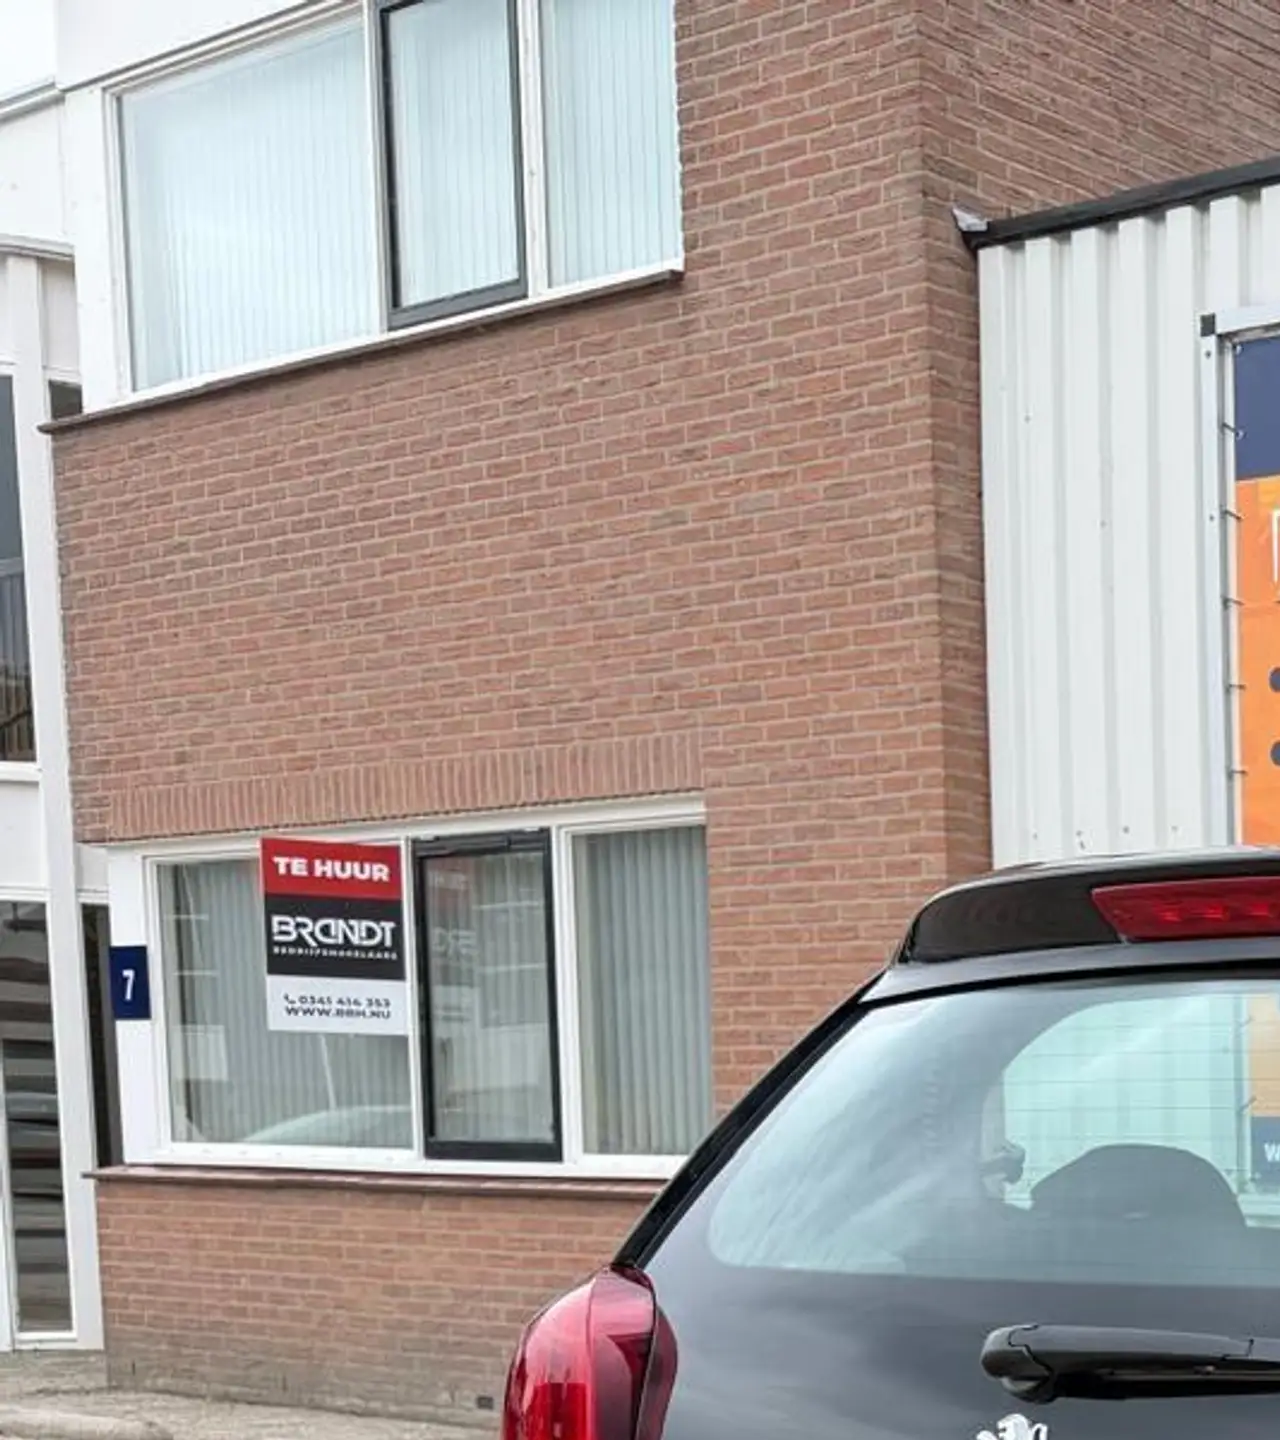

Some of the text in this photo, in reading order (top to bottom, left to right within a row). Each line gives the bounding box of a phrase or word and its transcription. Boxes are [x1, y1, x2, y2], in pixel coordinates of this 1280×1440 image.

[271, 856, 390, 882] TE HUUR
[122, 968, 135, 1001] 7
